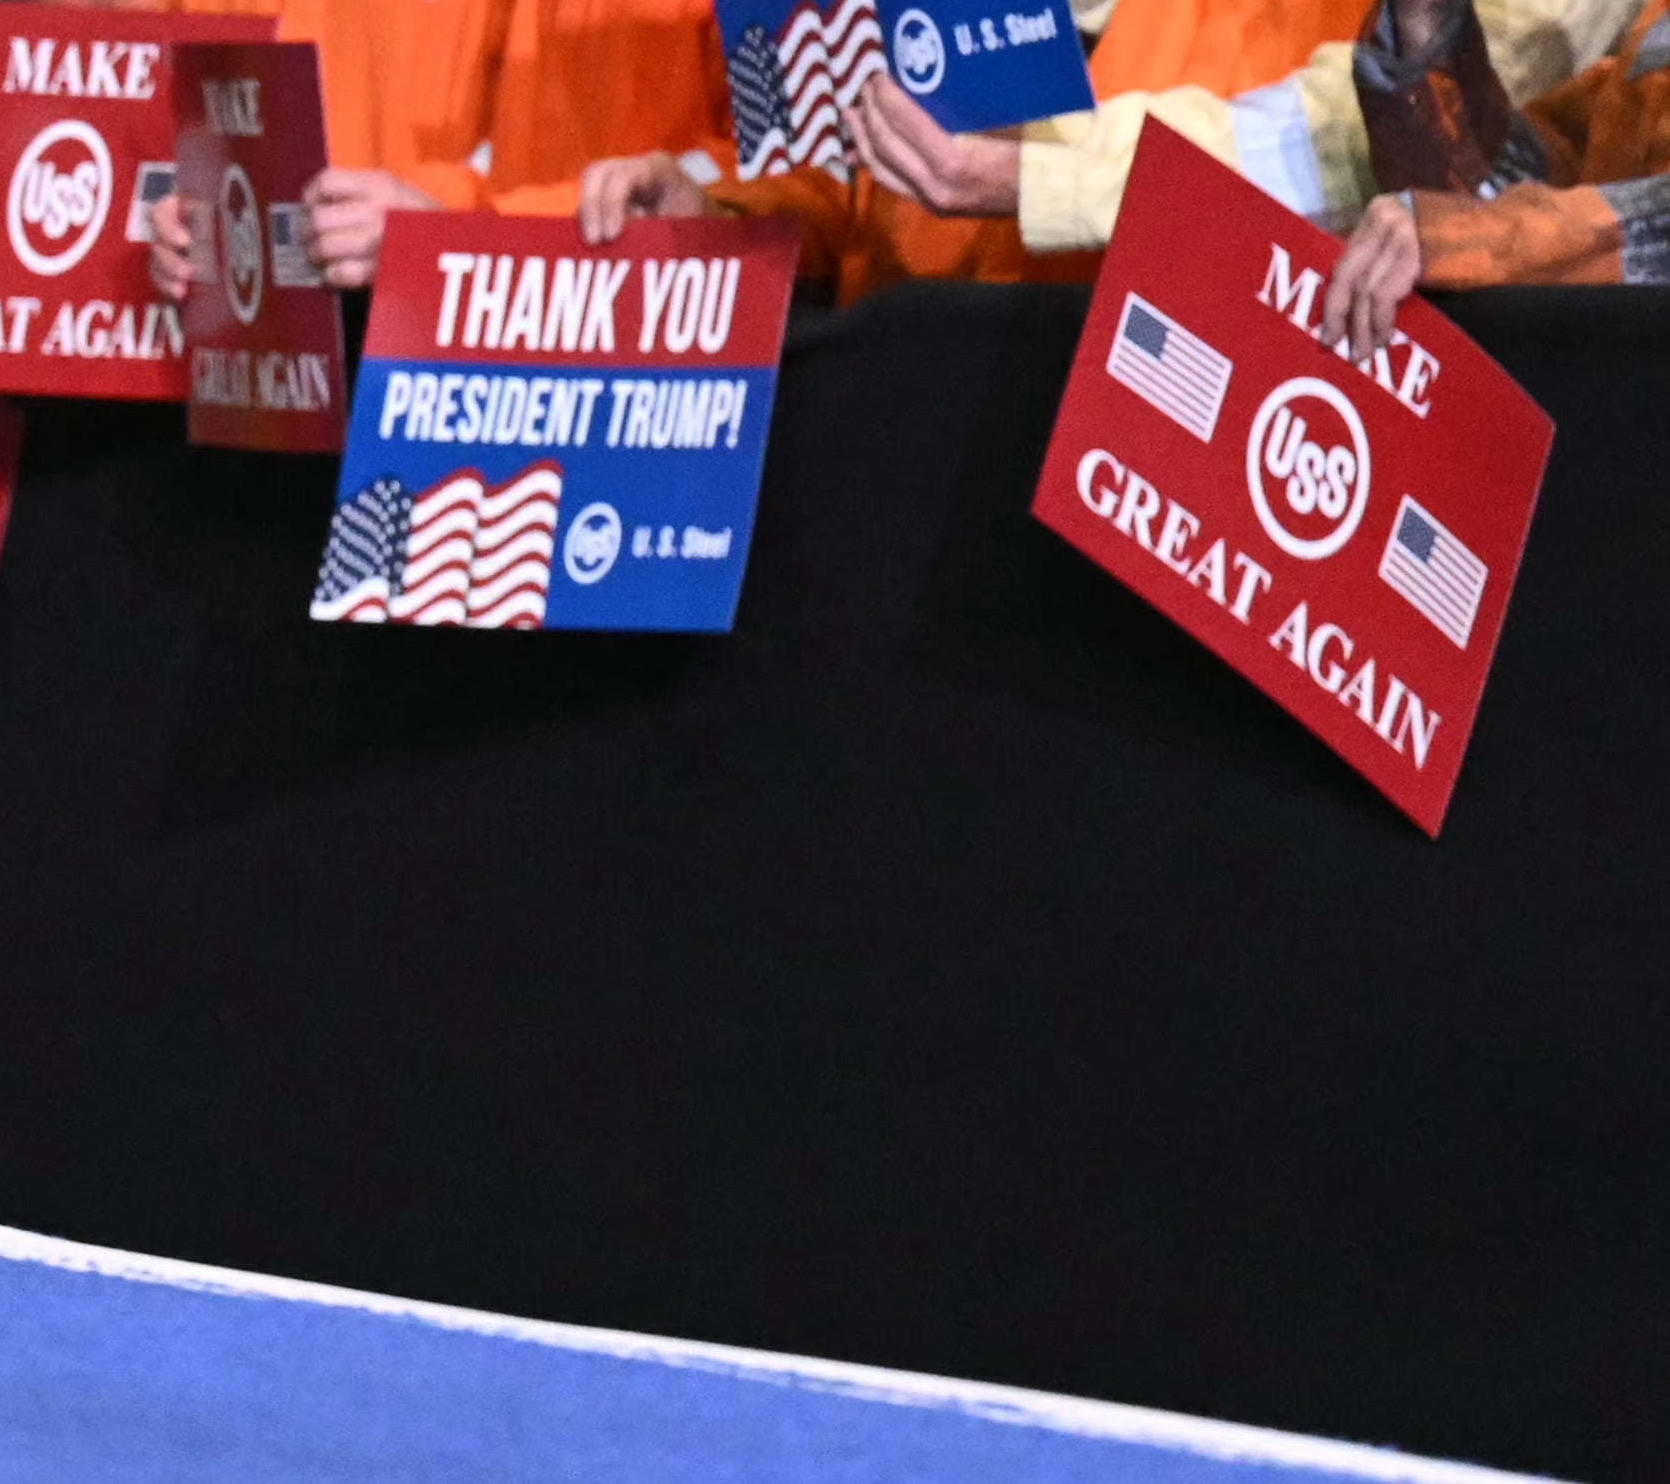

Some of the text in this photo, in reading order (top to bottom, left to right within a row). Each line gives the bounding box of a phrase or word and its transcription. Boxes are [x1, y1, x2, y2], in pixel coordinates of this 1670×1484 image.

[1, 36, 161, 100] MAKE
[953, 22, 981, 57] U.
[21, 161, 100, 240] USS
[434, 251, 742, 355] THANK YOU
[1255, 241, 1441, 420] ME
[378, 371, 748, 450] PRESIDENT TRUMP!
[1263, 405, 1358, 521] USS
[1075, 447, 1442, 771] GREAT AGAIN
